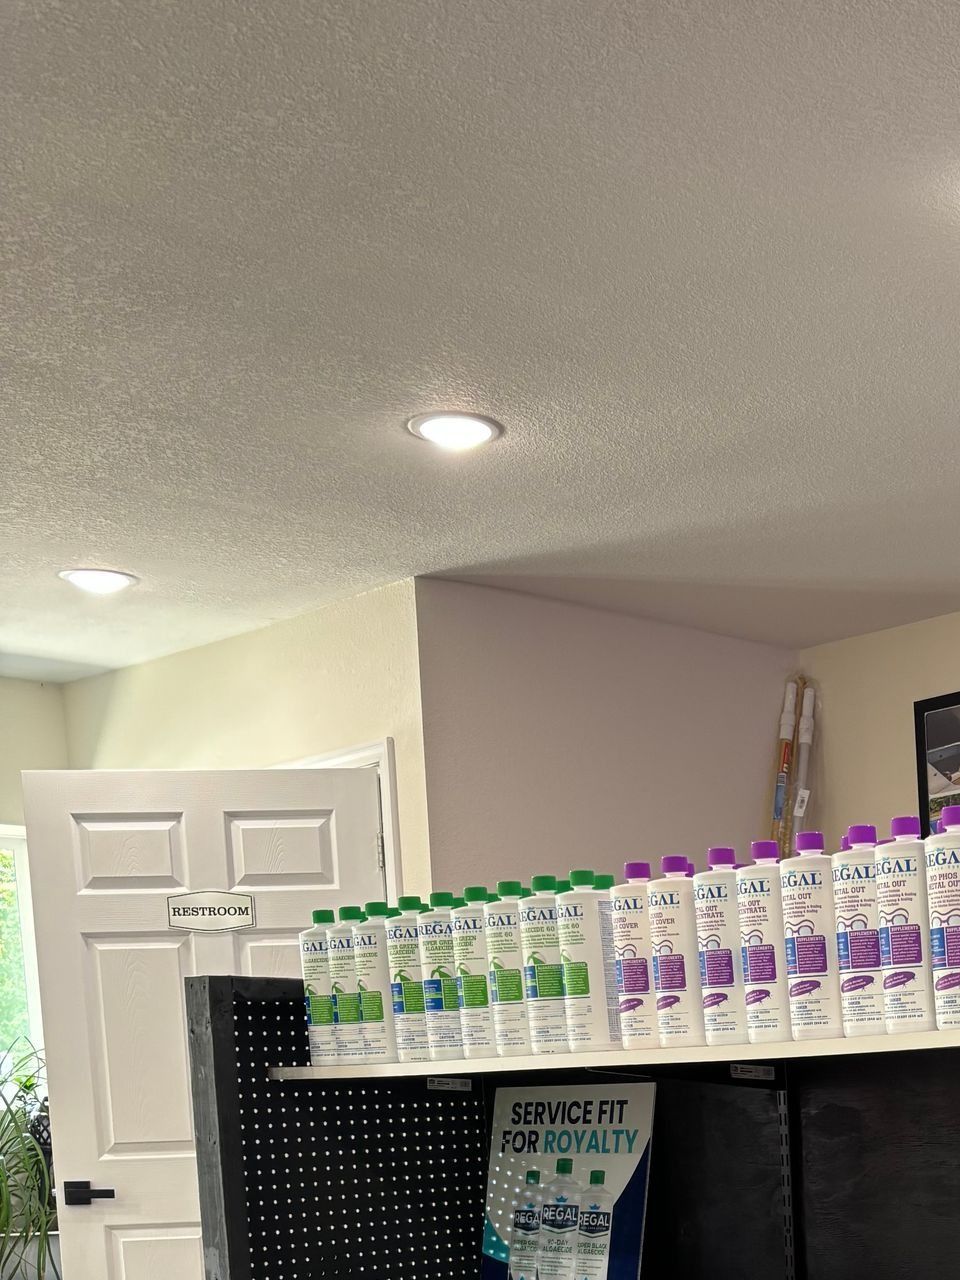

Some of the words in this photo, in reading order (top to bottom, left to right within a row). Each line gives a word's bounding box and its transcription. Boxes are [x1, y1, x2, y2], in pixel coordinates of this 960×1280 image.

[938, 872, 958, 880] PHOS
[172, 906, 250, 916] RESTROOM
[511, 1100, 594, 1126] SERVICE
[598, 1100, 628, 1124] FIT
[501, 1130, 539, 1154] FOR
[544, 1129, 639, 1154] ROYALTY
[543, 1207, 577, 1220] REGAL
[579, 1214, 610, 1226] REGAL
